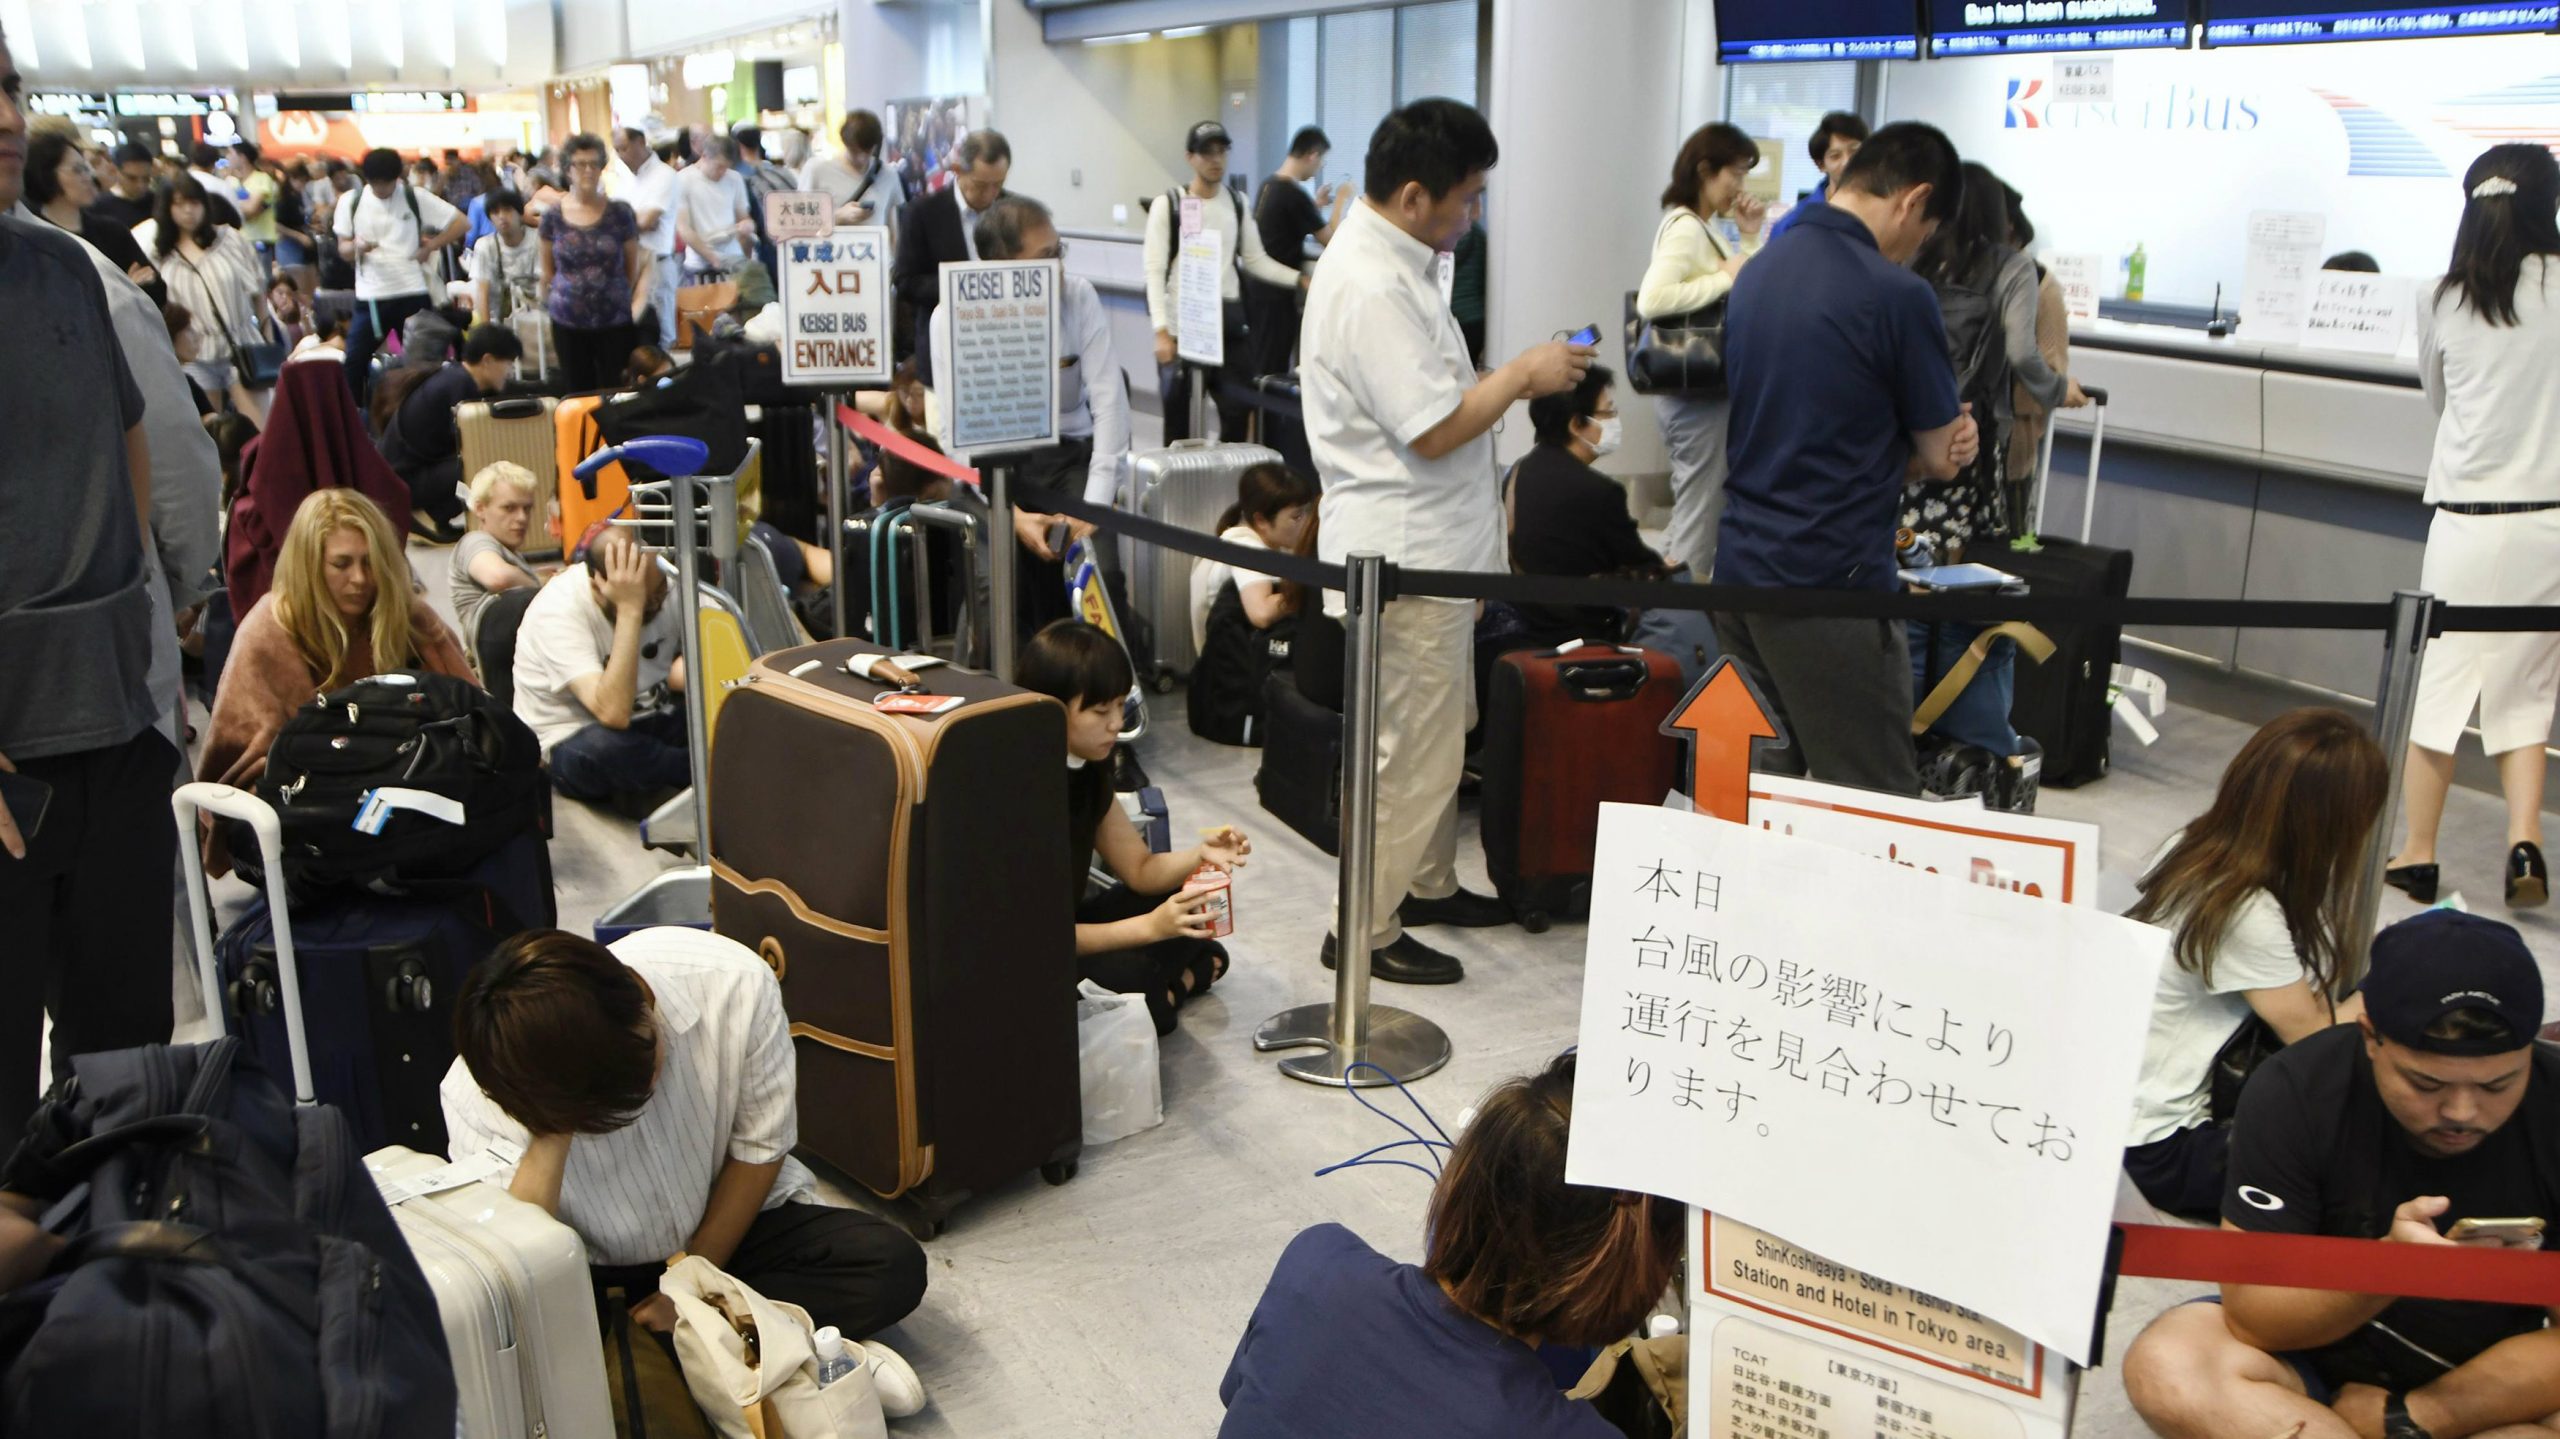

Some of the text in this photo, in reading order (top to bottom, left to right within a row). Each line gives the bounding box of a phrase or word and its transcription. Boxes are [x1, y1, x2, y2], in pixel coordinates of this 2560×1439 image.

[1965, 3, 1994, 26] Bus
[1995, 2, 2024, 24] has
[2025, 0, 2064, 23] been
[2166, 84, 2259, 131] Bus
[806, 268, 861, 296] 入口
[957, 269, 1042, 301] KEISEI BUS
[799, 312, 868, 334] KEISEI BUS
[794, 338, 876, 369] ENTRANCE
[1632, 857, 1722, 913] 本日
[1631, 924, 2014, 1068] 台風の影響により
[1621, 990, 2077, 1162] 運行を見合わせてお
[1626, 1055, 1770, 1138] ります。
[1755, 1238, 1846, 1284] ShinKoshigaya
[1733, 1259, 2011, 1362] Station and Hotel in Tokyo area.
[1732, 1346, 1768, 1367] TCAT
[1733, 1364, 1832, 1408] 日比谷・銀座方面
[1731, 1414, 1802, 1439] 芝・汐留方
[1874, 1412, 1953, 1439] 渋谷・二子
